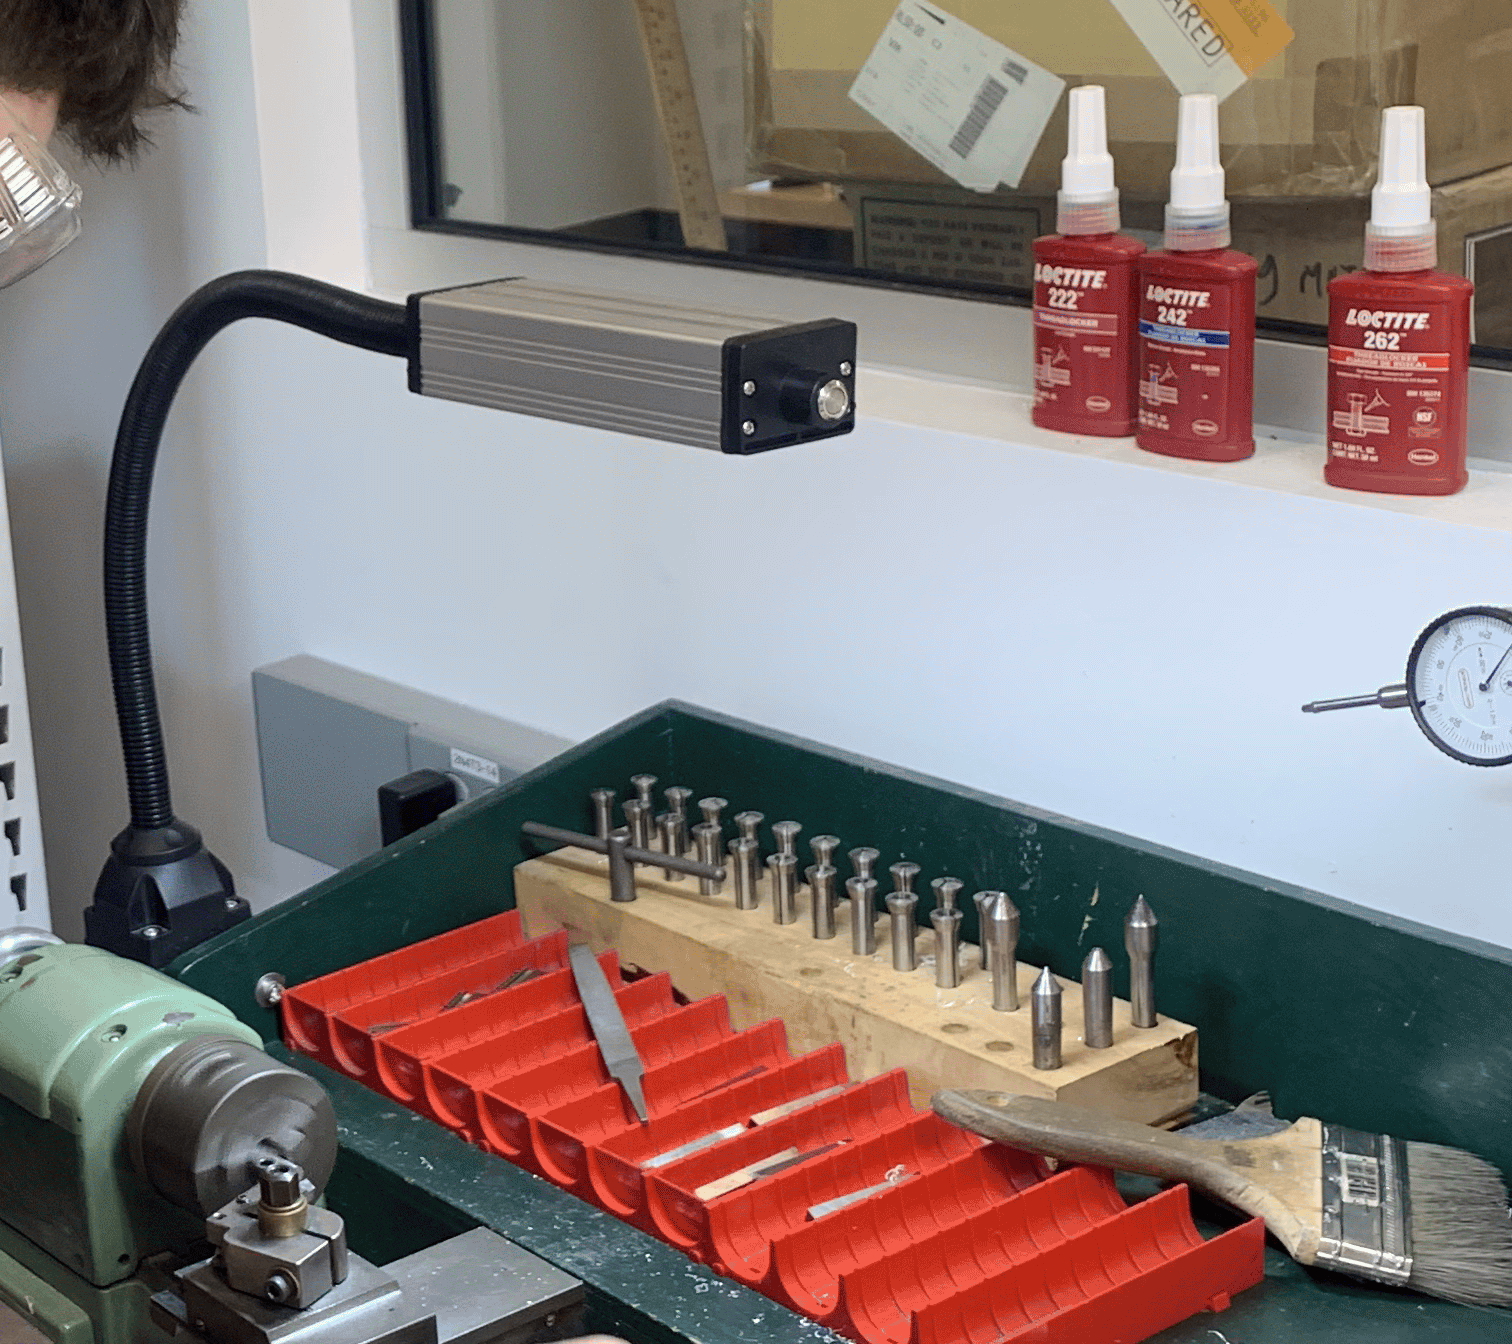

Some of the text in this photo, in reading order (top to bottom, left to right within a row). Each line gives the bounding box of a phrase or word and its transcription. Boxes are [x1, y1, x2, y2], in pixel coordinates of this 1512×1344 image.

[1034, 263, 1106, 289] LOCTITE
[1048, 287, 1078, 310] 222
[1146, 285, 1210, 308] LOCTITE
[1158, 306, 1187, 326] 242
[1346, 308, 1430, 330] LOCTITE
[1364, 330, 1400, 350] 262
